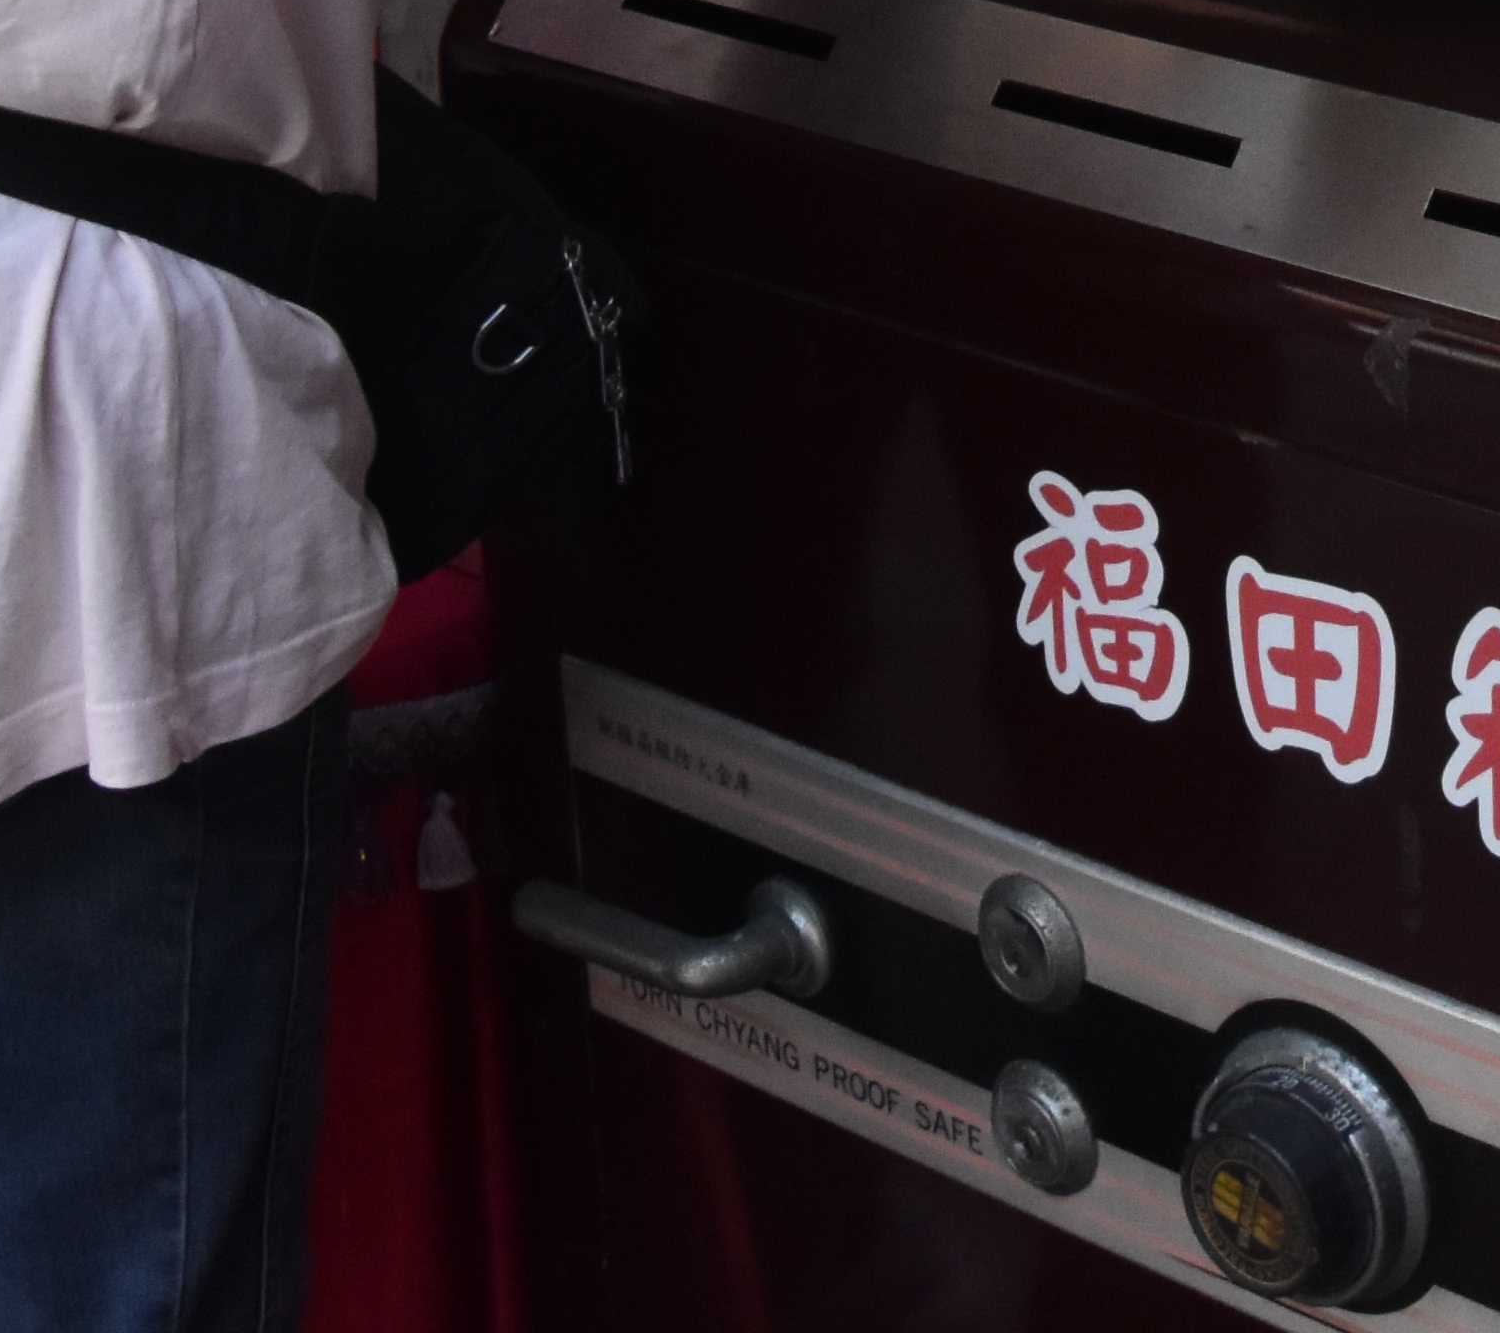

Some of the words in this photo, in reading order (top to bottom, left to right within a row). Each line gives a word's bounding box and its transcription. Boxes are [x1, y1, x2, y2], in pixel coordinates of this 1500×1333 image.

[695, 1002, 800, 1071] CHYANG
[813, 1052, 902, 1116] PROOF
[914, 1101, 985, 1156] SAFE
